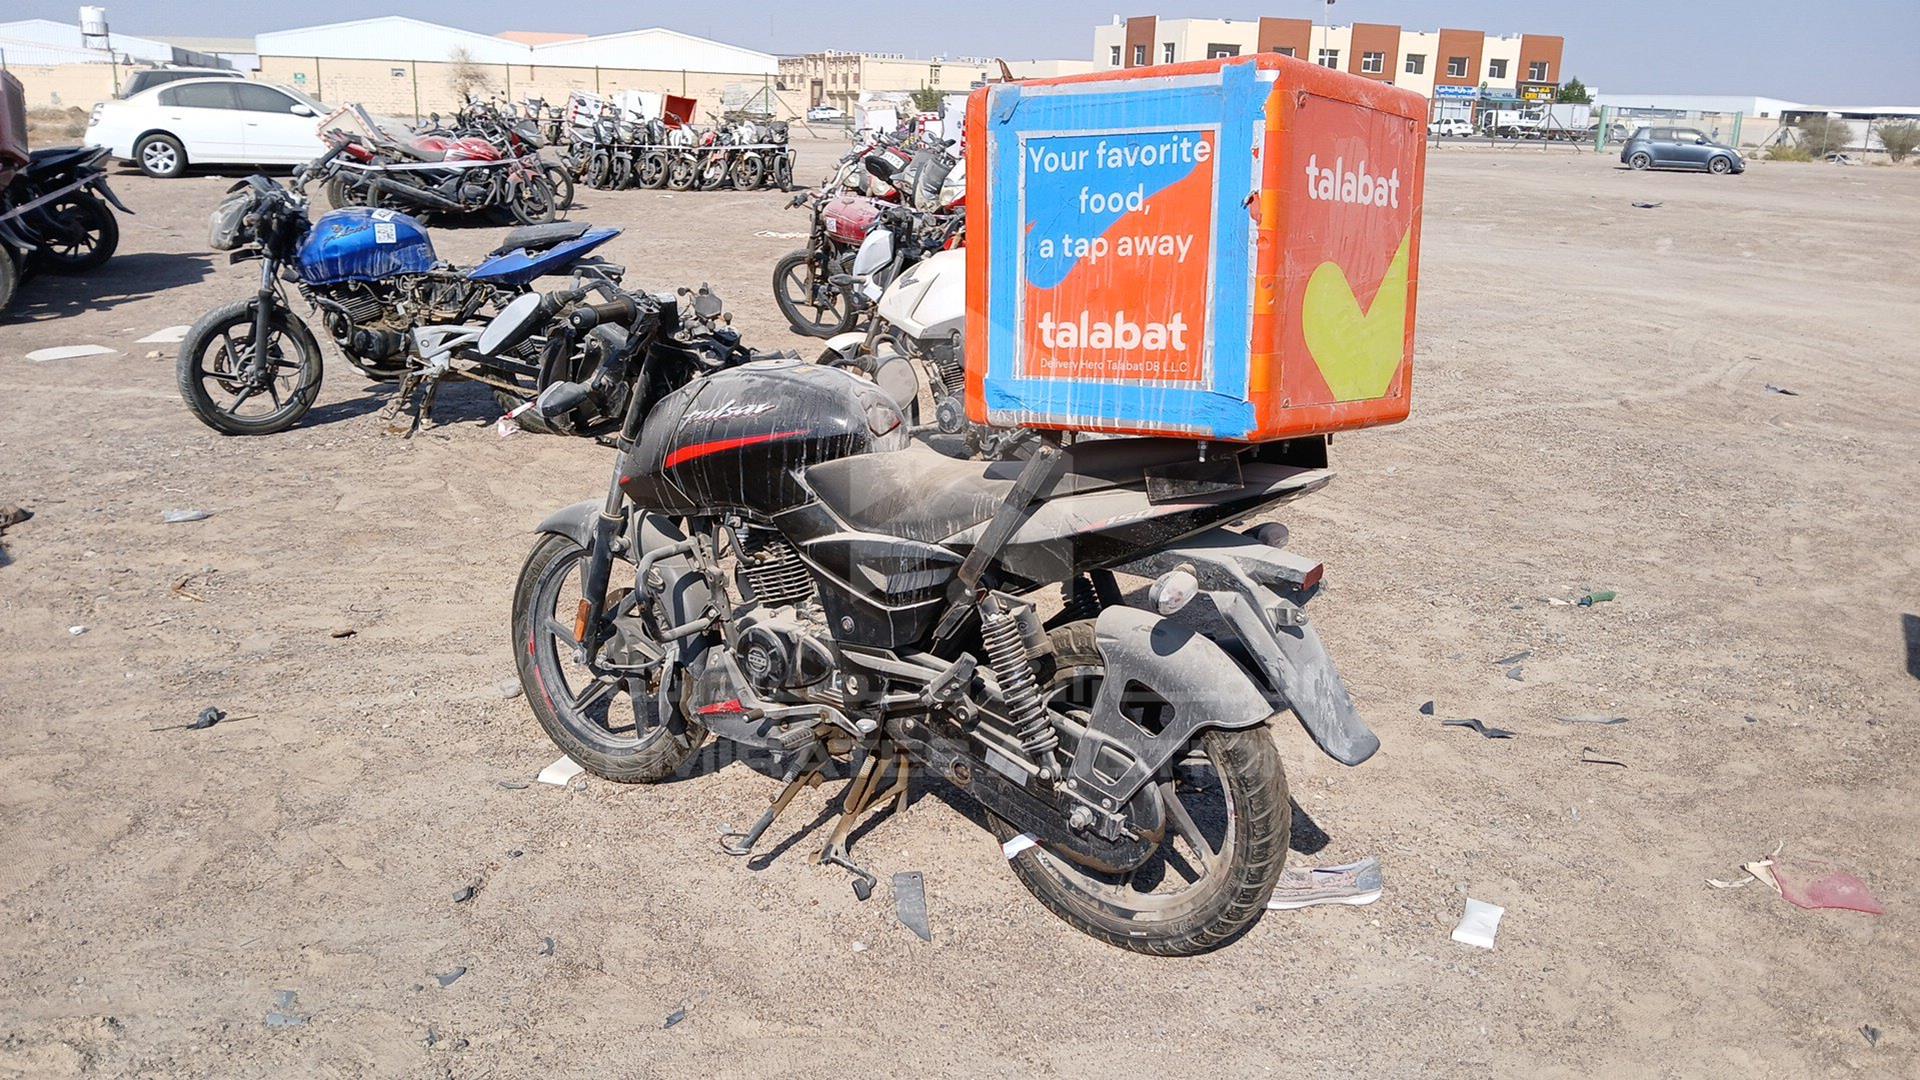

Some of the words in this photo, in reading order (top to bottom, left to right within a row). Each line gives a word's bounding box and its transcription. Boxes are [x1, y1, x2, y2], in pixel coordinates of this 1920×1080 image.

[1028, 145, 1089, 174] Your
[1096, 134, 1211, 169] favorite
[1079, 182, 1151, 215] food,
[1305, 153, 1400, 209] talabat
[1039, 238, 1054, 259] a
[1062, 233, 1109, 265] tap
[1117, 233, 1194, 264] away
[1038, 309, 1188, 351] talabat
[1040, 358, 1078, 371] Delivery
[1080, 359, 1105, 371] Hero
[1106, 359, 1144, 371] Talabat
